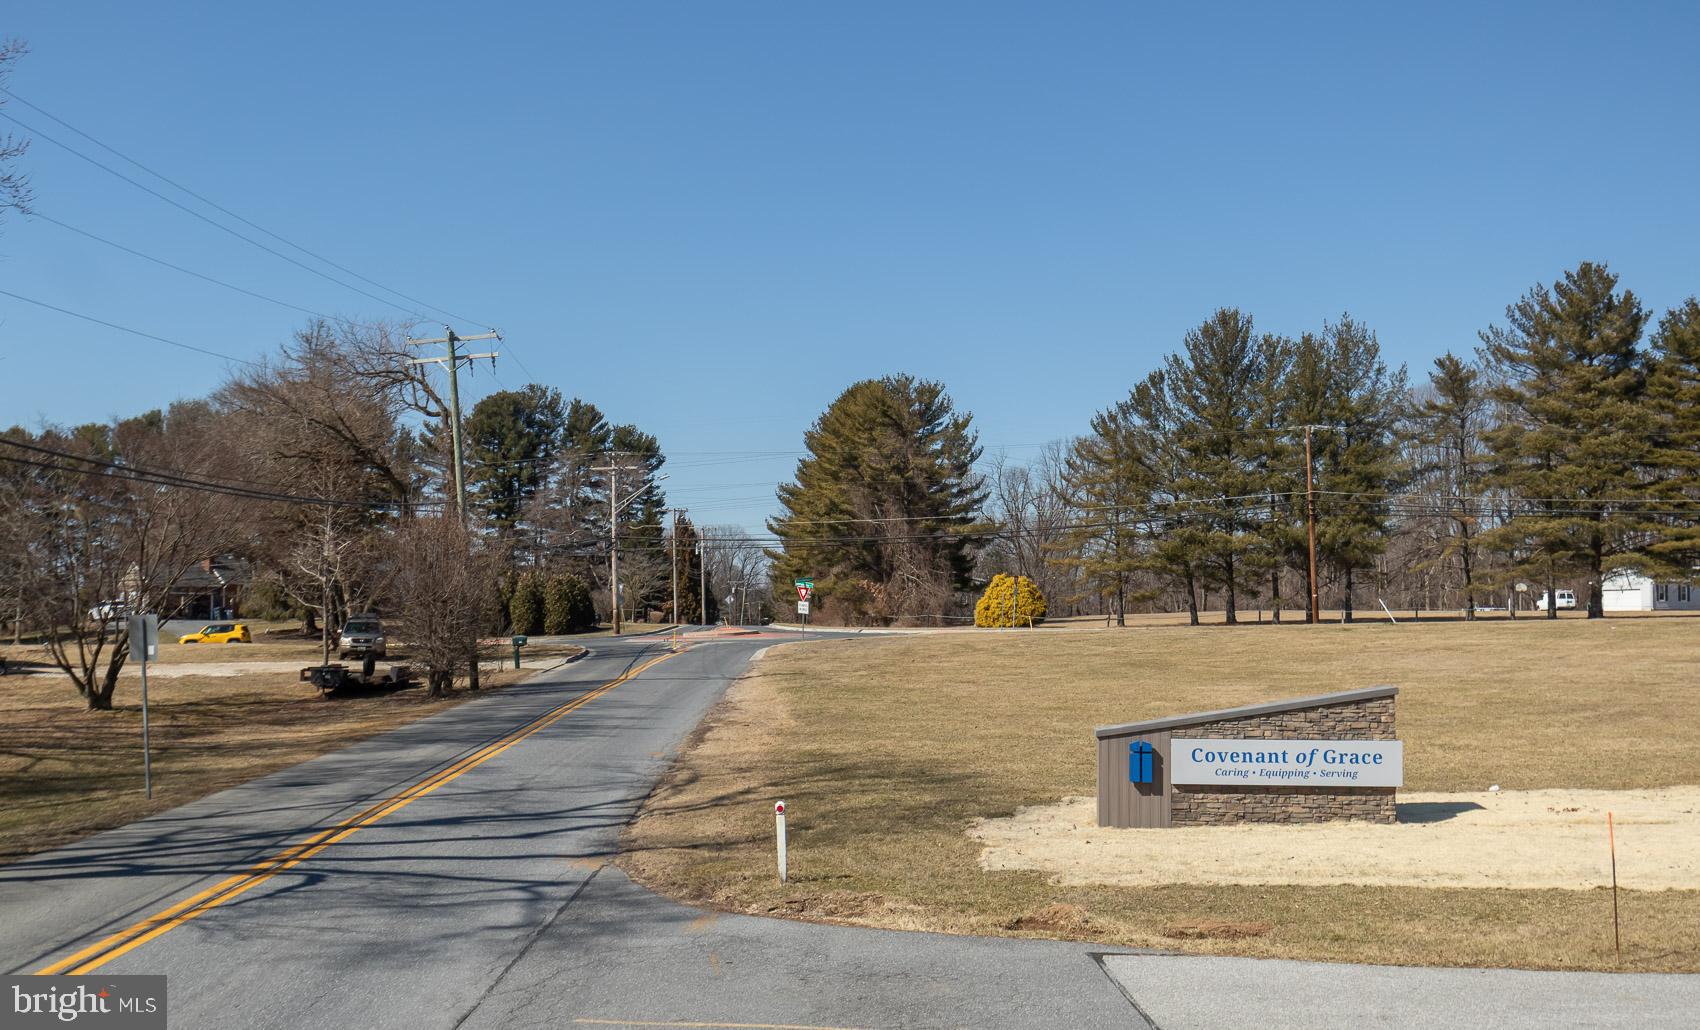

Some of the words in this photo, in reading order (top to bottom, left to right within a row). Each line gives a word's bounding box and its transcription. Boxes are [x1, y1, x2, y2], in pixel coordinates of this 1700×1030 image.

[1191, 748, 1288, 764] Covenant
[1296, 748, 1319, 767] of
[1323, 749, 1383, 765] Grace
[1215, 768, 1249, 778] Caring
[1259, 769, 1310, 779] Equipping
[1320, 769, 1359, 779] Serving
